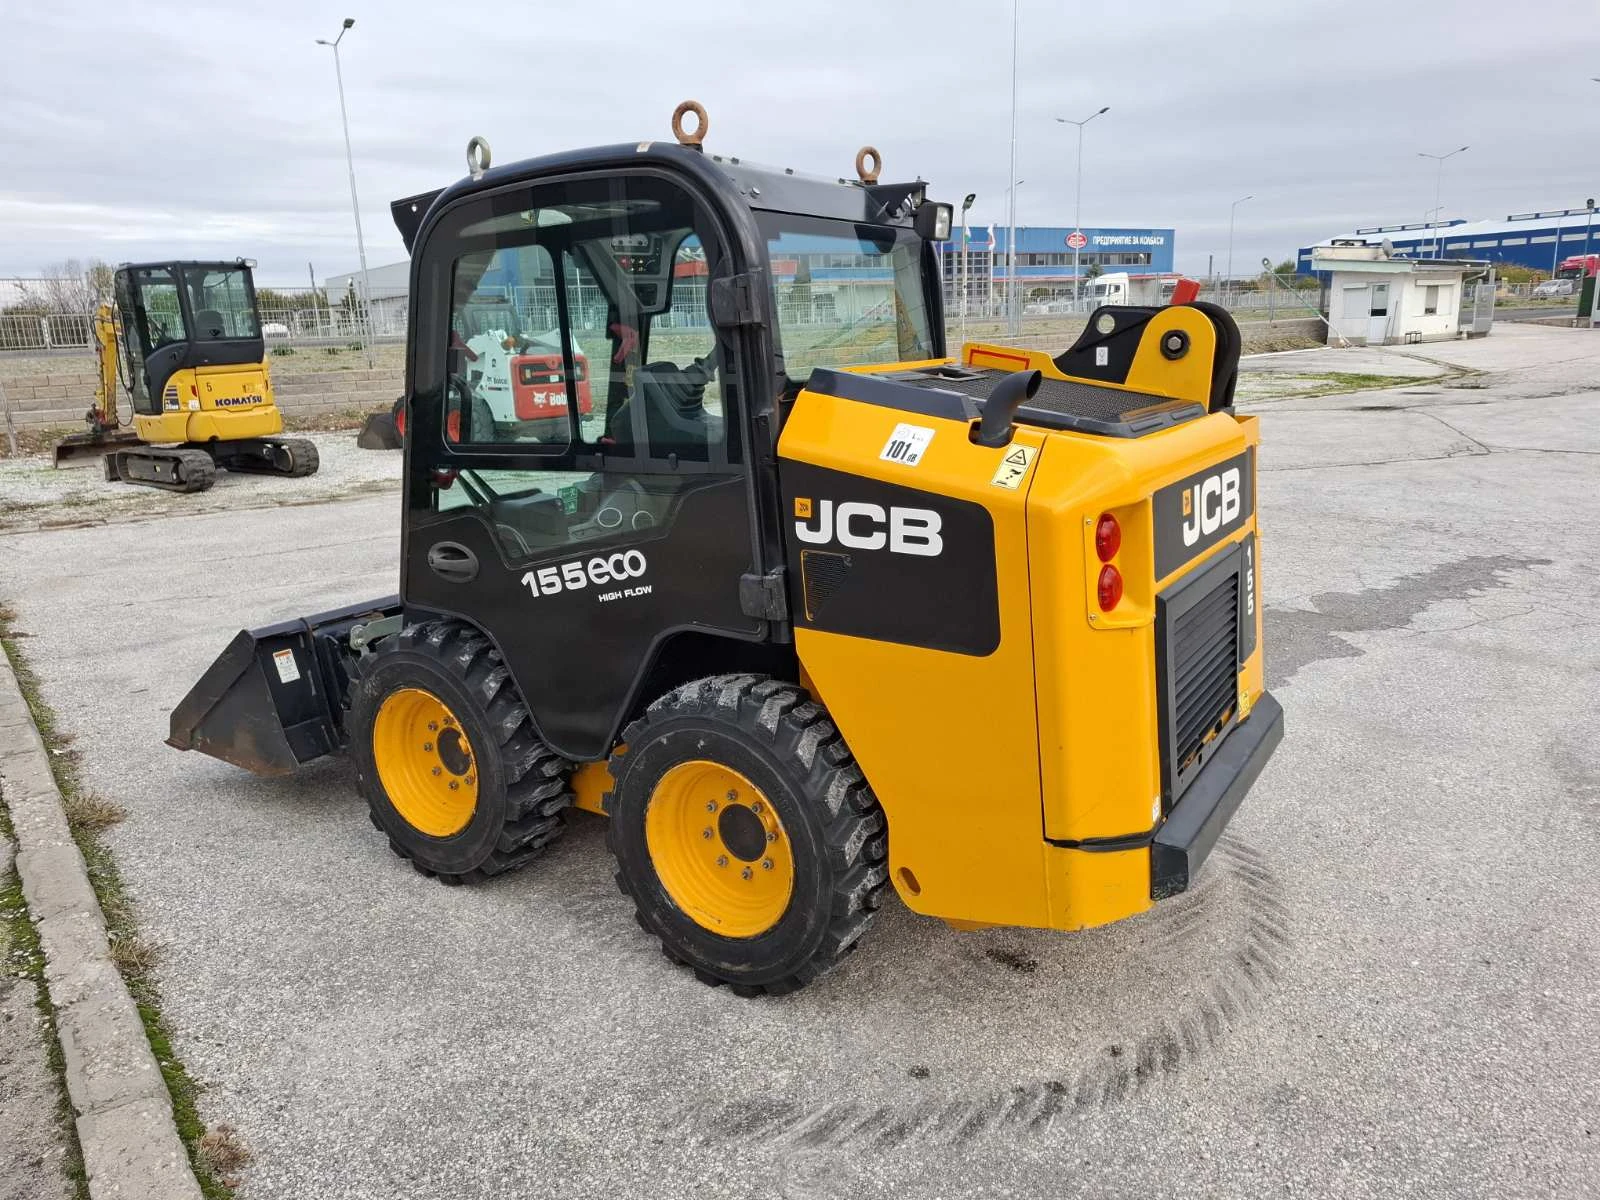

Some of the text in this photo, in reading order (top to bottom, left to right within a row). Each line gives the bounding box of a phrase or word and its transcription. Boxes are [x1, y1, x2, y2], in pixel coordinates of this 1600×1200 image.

[1093, 235, 1131, 245] ПРЕДПРИЯТИЕ
[215, 396, 262, 407] KOMATSU
[549, 392, 568, 406] Bob
[887, 439, 912, 460] 101
[1183, 467, 1240, 547] JCB
[795, 500, 944, 557] JCB
[598, 585, 652, 602] HIGH FLOW
